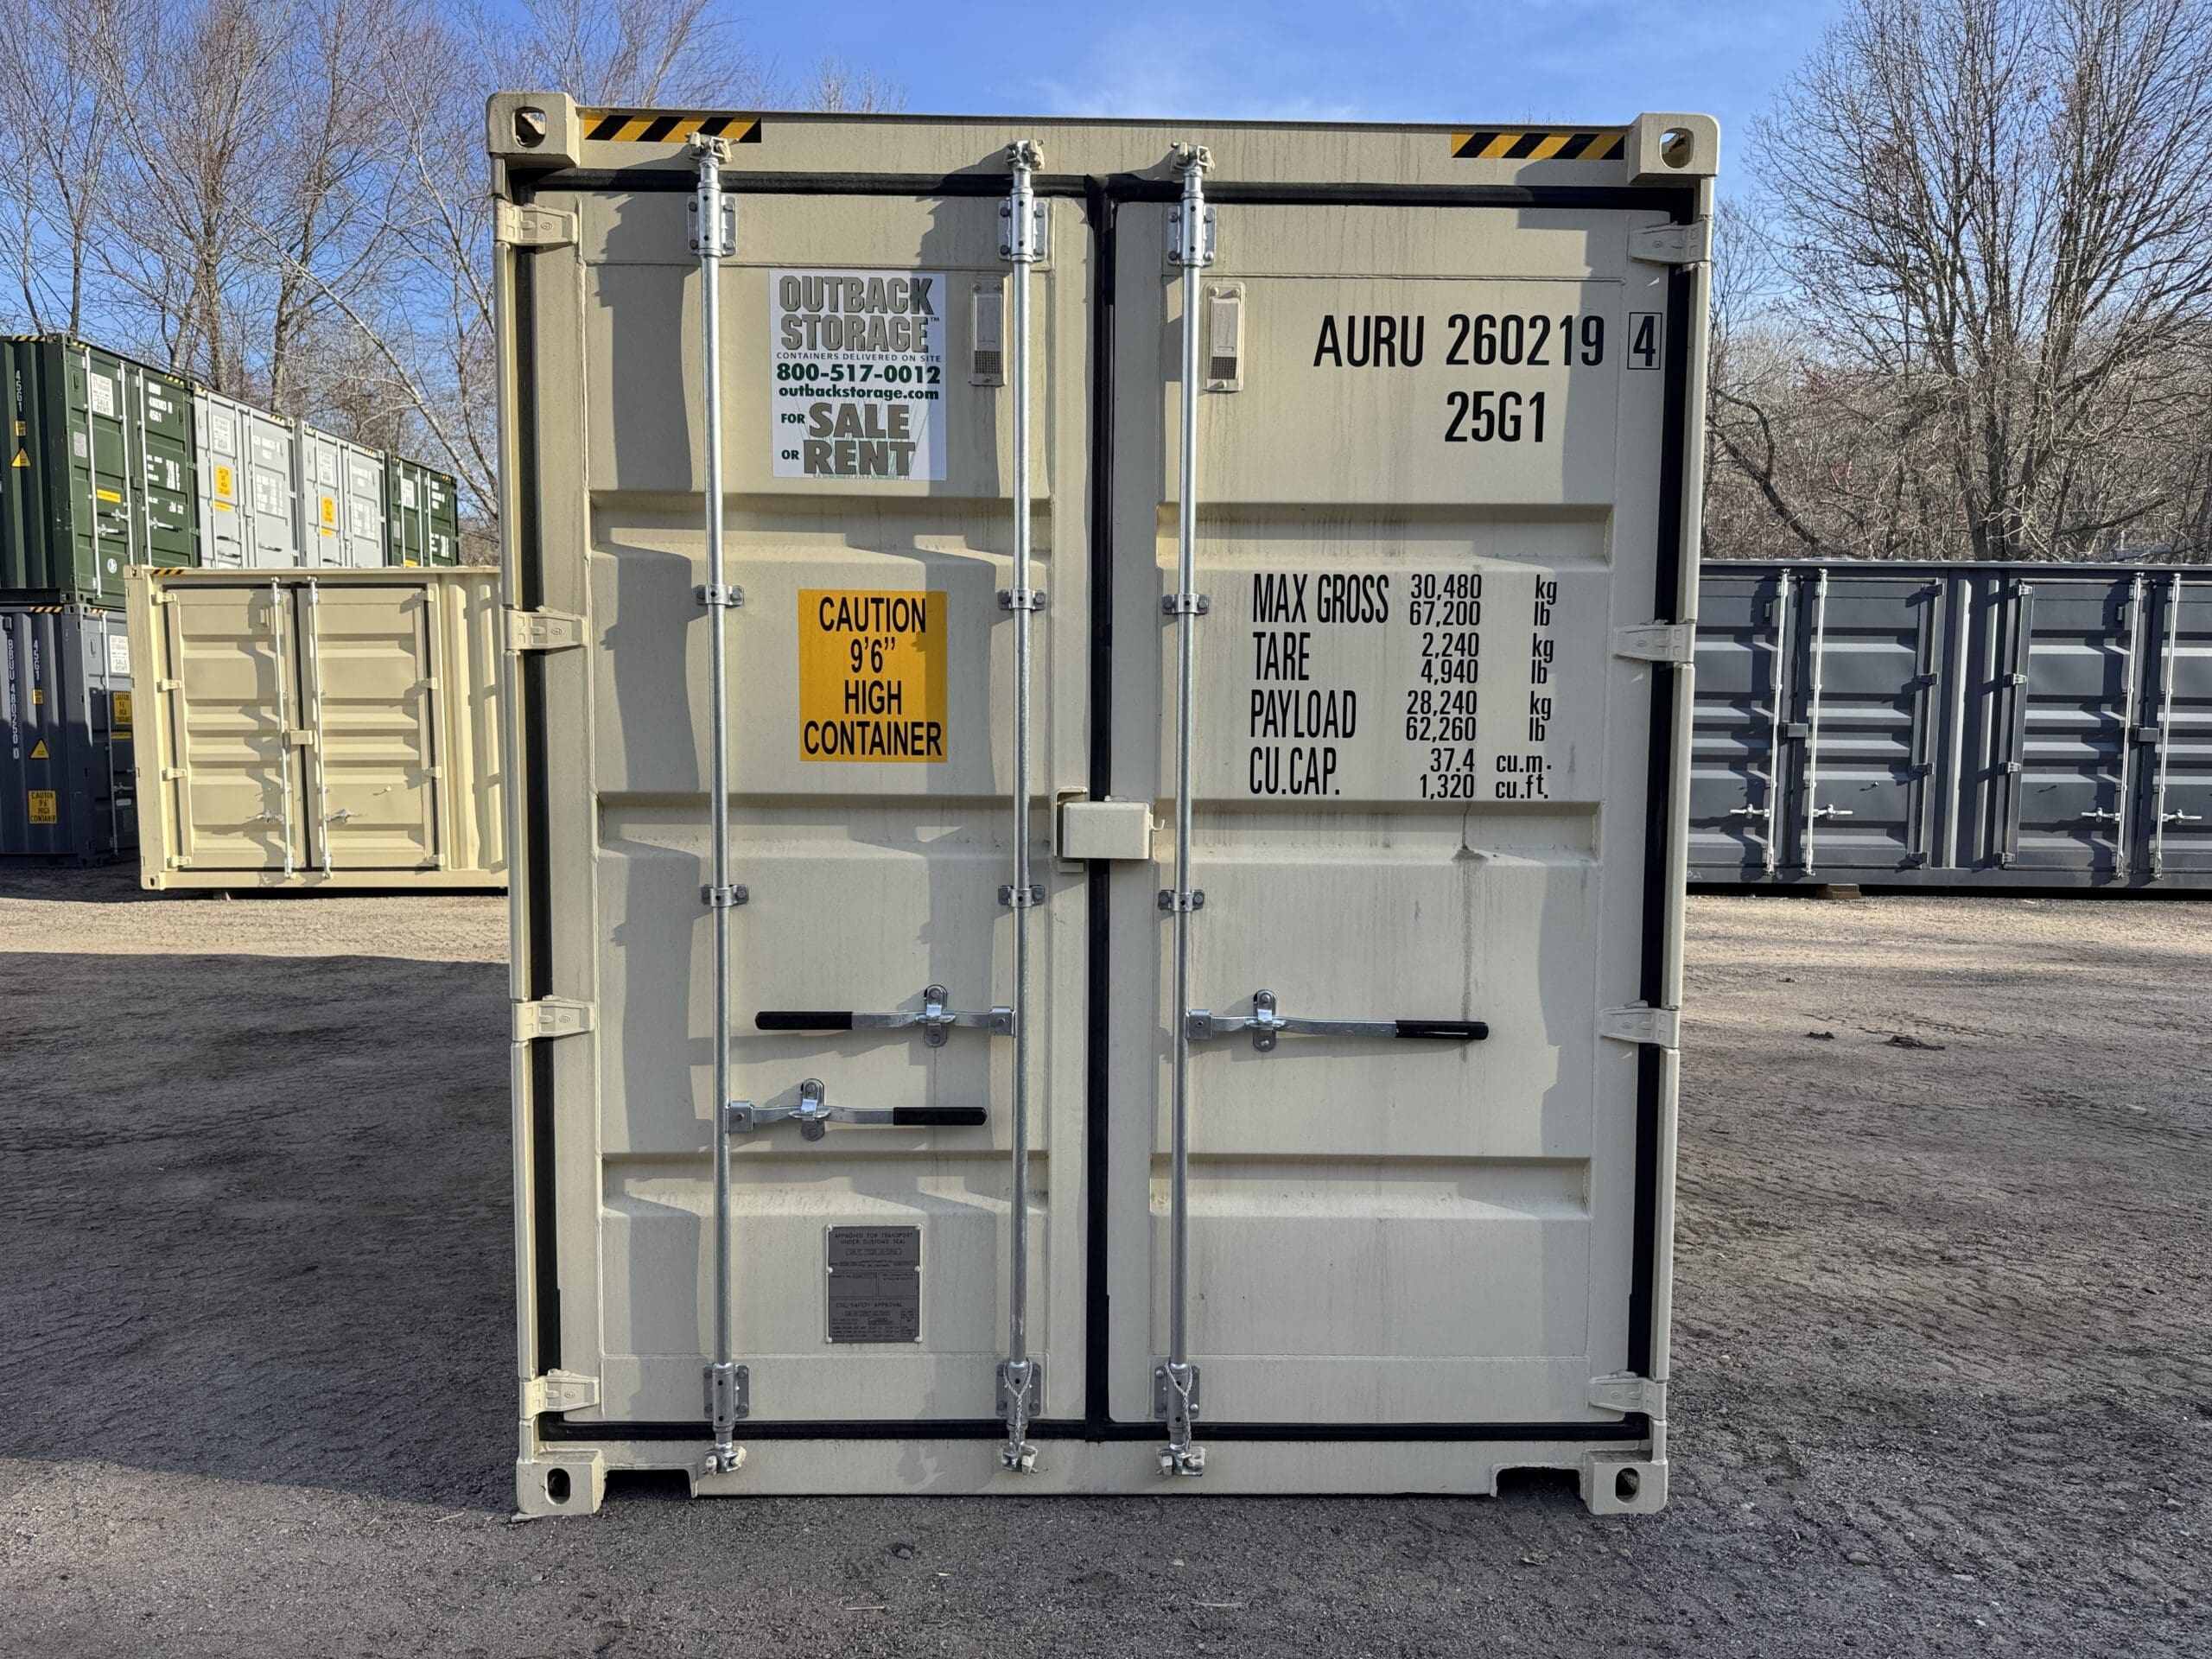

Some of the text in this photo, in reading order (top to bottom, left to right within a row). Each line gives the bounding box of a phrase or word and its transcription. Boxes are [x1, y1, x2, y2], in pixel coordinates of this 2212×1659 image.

[779, 275, 934, 315] OUTBACK
[780, 314, 929, 353] STORAGE
[1313, 314, 1657, 367] AURU 260219 4
[776, 352, 839, 360] CONTAINERS
[842, 353, 898, 362] DELIVERED
[776, 363, 941, 385] 800-517-0012
[779, 385, 939, 401] outbackstorage.com
[780, 402, 910, 439] FOR SALE
[1445, 391, 1545, 442] 25G1
[781, 439, 916, 476] OR RENT
[1253, 574, 1389, 623] MAX GROSS
[1410, 574, 1558, 606] 30,480 kg
[818, 596, 927, 633] CAUTION
[1409, 601, 1552, 627] 67,200 lb
[7, 639, 16, 681] BBUU
[1252, 632, 1311, 681] TARE
[1421, 632, 1554, 664] 2,240 kg
[1421, 659, 1548, 685] 4,940 lb
[844, 679, 902, 715] HIGH
[1250, 690, 1357, 739] PAYLOAD
[1407, 690, 1552, 721] 28,240 kg
[804, 720, 943, 756] CONTAINER
[1406, 716, 1546, 743] 62,260 lb
[1249, 746, 1340, 796] CU.CAP.
[1430, 748, 1552, 773] 37.4 cu.m.
[1420, 774, 1548, 800] 1,320 cu.ft.
